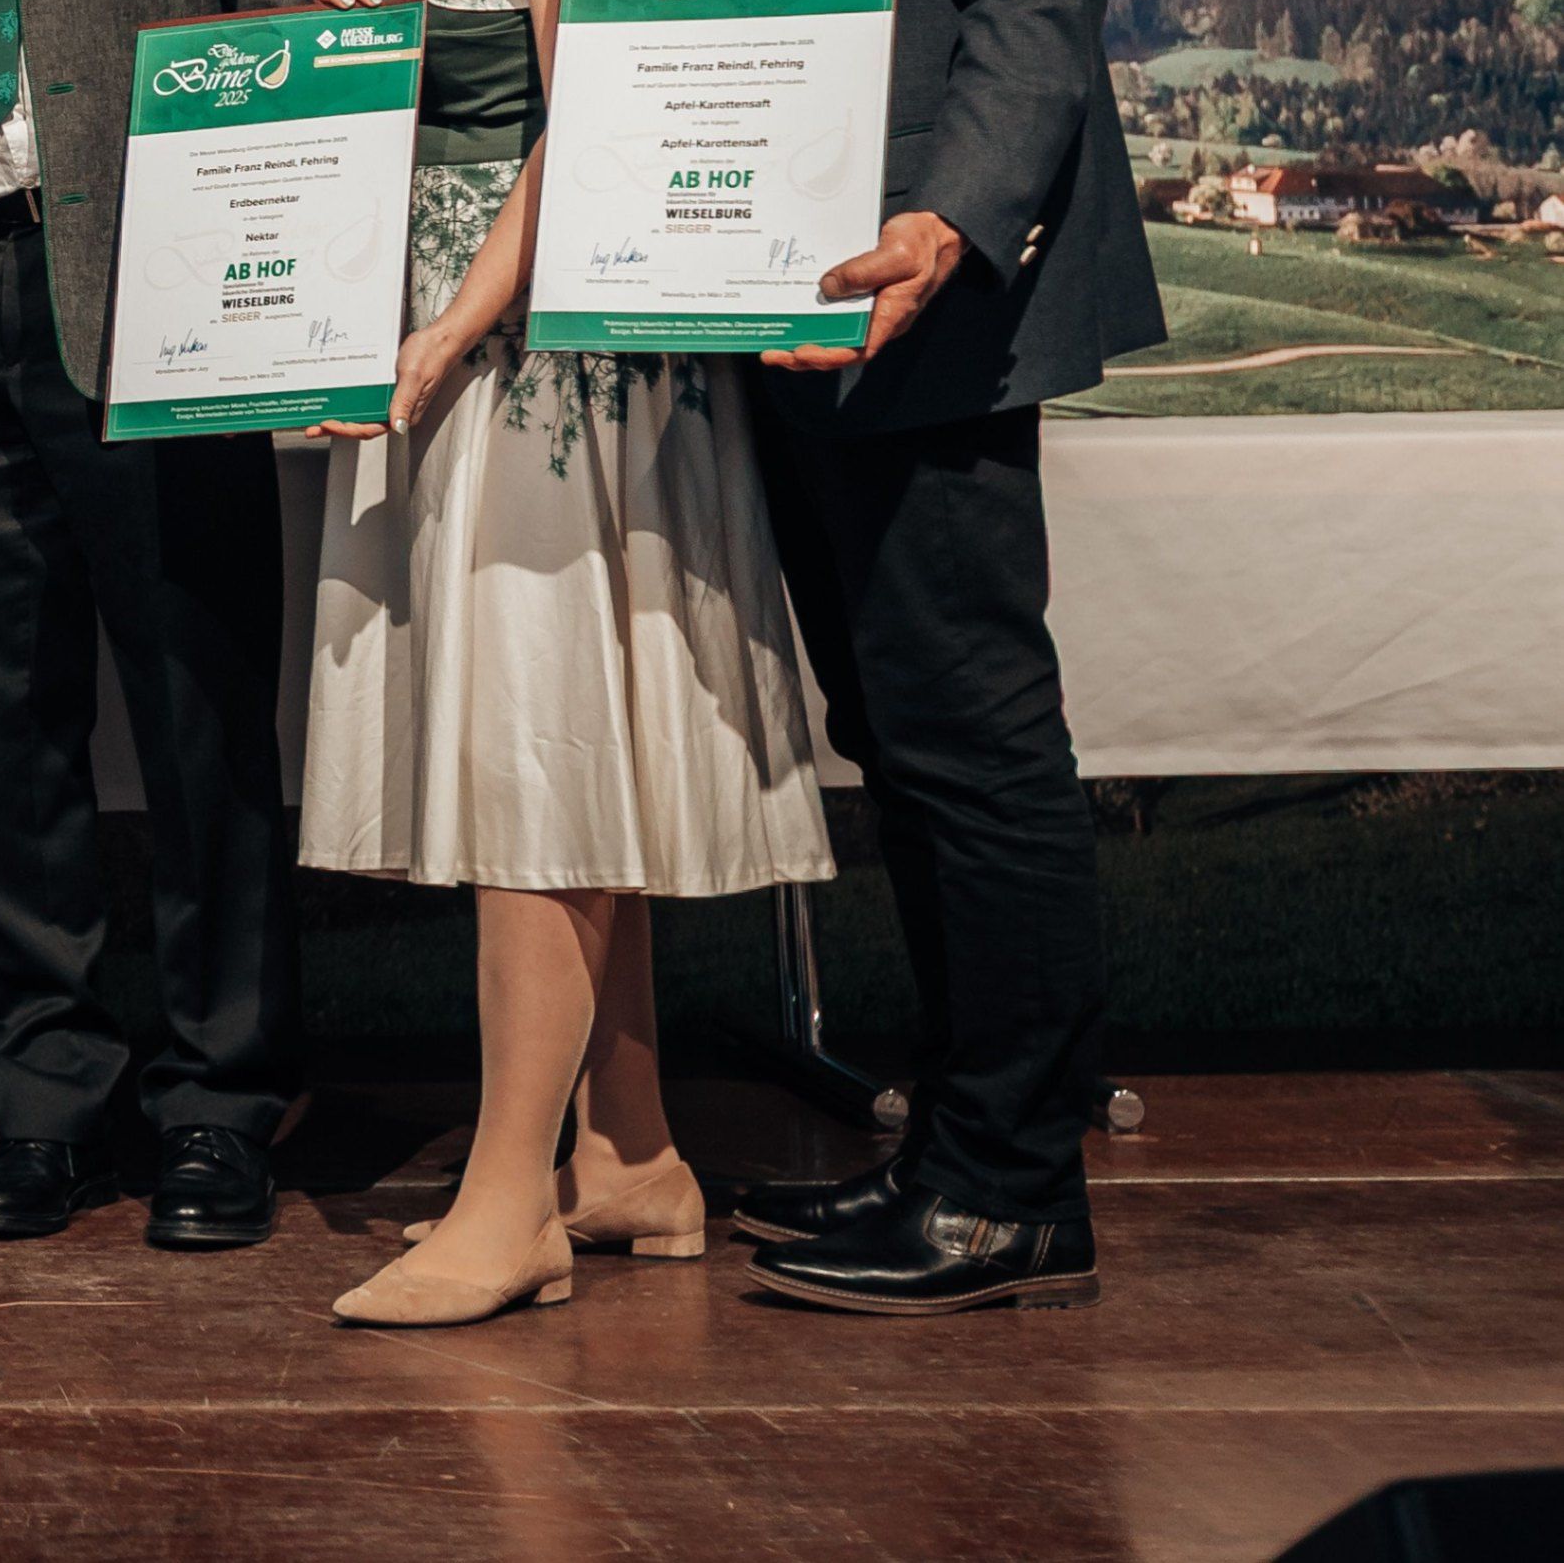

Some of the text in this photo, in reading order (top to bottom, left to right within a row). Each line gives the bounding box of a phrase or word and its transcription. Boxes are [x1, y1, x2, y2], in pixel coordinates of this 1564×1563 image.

[637, 58, 805, 73] Familie Franz Reindl, Fehring
[153, 57, 252, 96] Birne
[215, 89, 251, 108] 2025
[664, 99, 771, 112] Apfel-Karottensaft
[660, 138, 769, 150] Apfel-Karottensaft
[196, 165, 232, 177] Familie
[234, 163, 262, 173] Franz
[300, 155, 339, 167] Fehring
[668, 169, 755, 189] AB HOF
[229, 194, 301, 209] Erdbeernektar
[665, 208, 752, 219] WIESELBURG
[665, 223, 712, 234] SIEGER
[245, 232, 280, 242] Nektar
[224, 258, 297, 281] AB HOF
[221, 294, 295, 309] WIESELBURG
[221, 311, 261, 323] SIEGER
